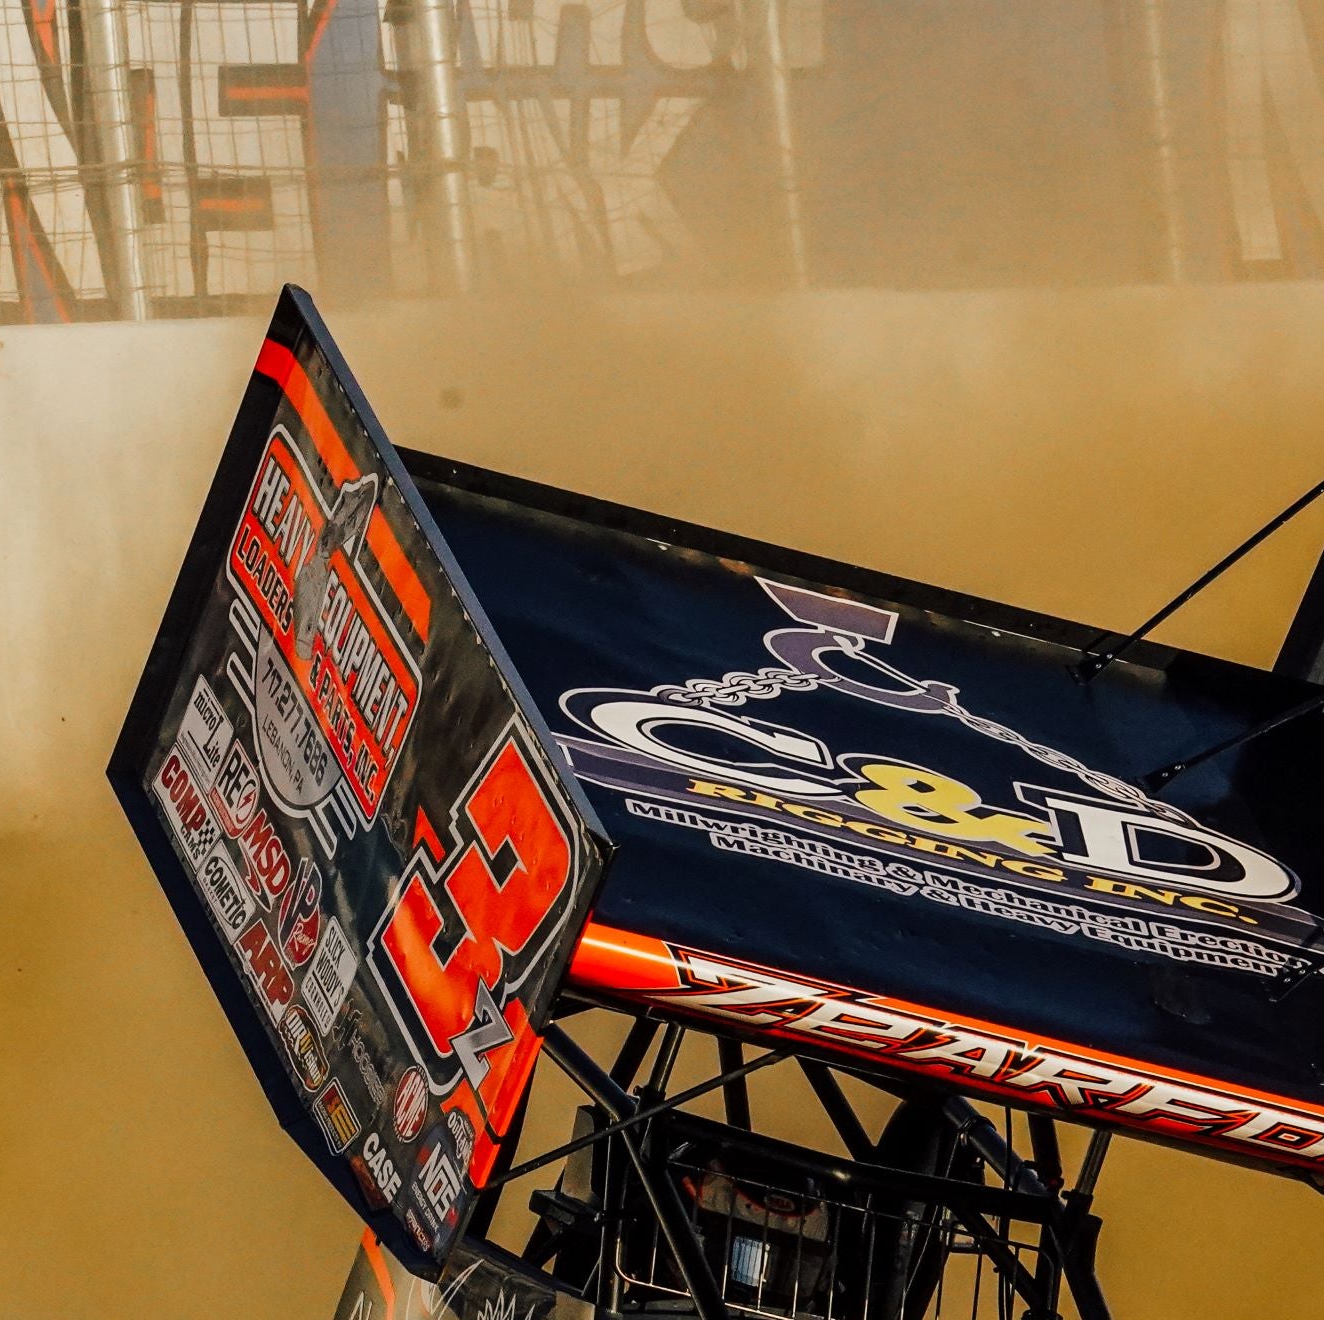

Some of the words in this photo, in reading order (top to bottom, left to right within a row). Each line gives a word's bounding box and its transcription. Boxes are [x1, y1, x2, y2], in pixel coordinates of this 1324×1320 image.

[252, 455, 316, 581] HEAVY
[235, 523, 294, 637] LOADERS
[161, 754, 207, 832] COMP
[204, 856, 247, 930] COMETIC
[239, 808, 292, 898] MSD
[686, 778, 1068, 883] RIGGING
[1083, 875, 1259, 925] INC.
[713, 832, 919, 896] Machinary
[961, 893, 1081, 937] Heavy
[1083, 924, 1289, 980] Equipmen
[928, 871, 1148, 936] Mechanical
[237, 920, 294, 1007] ARP
[315, 949, 345, 1007] WOODY'S
[325, 926, 346, 970] SLICK
[362, 1132, 403, 1204] CASE
[417, 1140, 462, 1223] NOS
